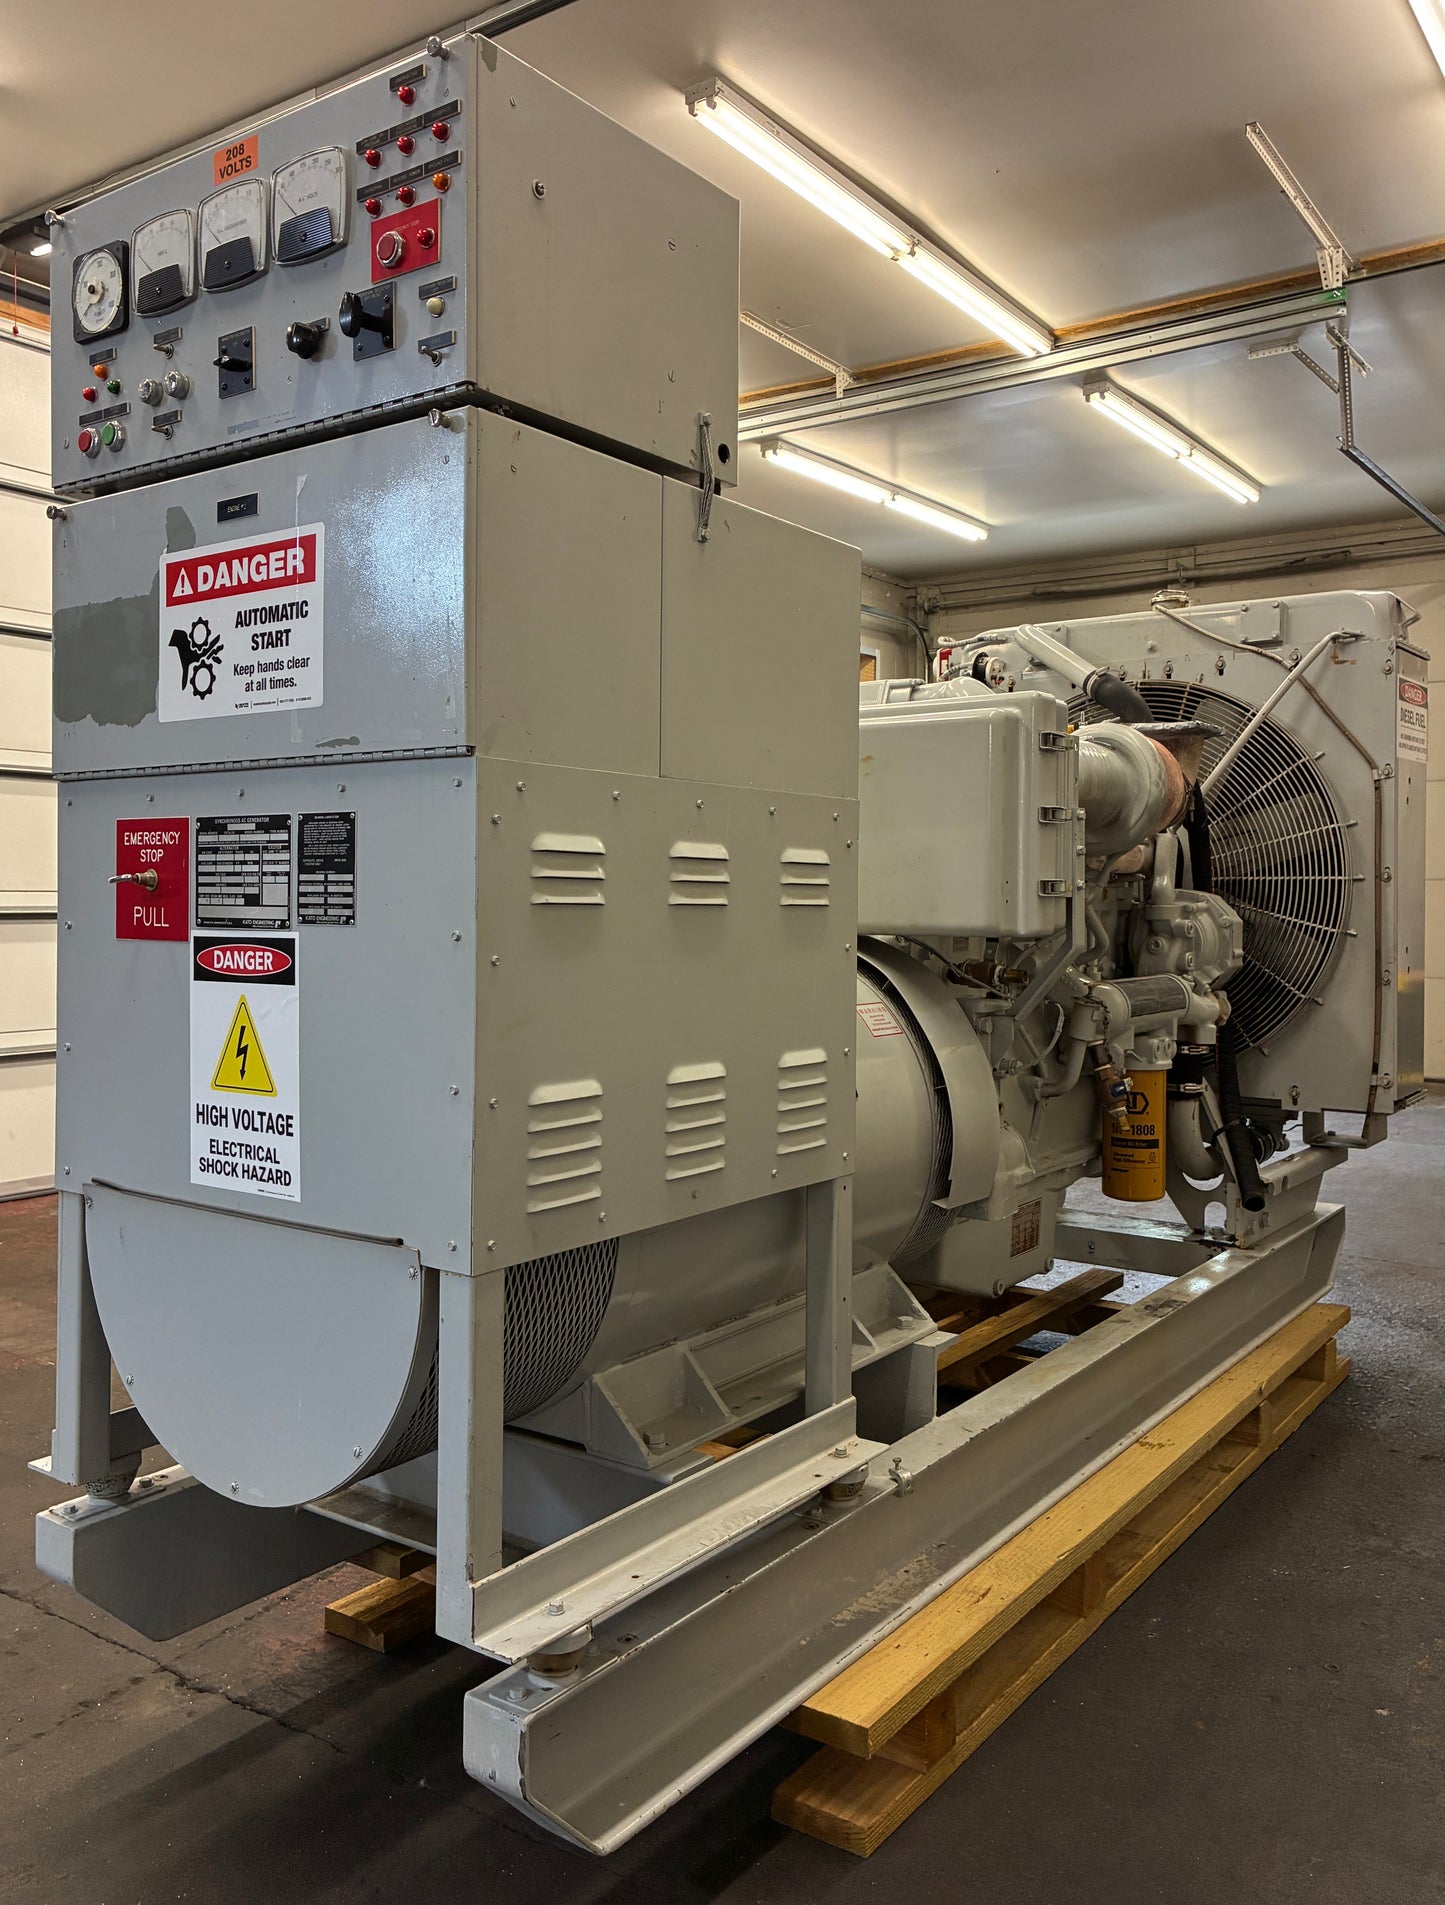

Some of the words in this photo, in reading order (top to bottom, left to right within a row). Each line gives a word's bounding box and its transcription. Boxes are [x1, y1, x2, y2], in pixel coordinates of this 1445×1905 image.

[225, 143, 245, 162] 208
[219, 155, 252, 179] VOLTS
[197, 547, 304, 593] DANGER
[234, 600, 308, 628] AUTOMATIC
[251, 628, 292, 651] START
[233, 662, 255, 678] Keep
[257, 658, 284, 674] hands
[286, 656, 310, 670] clear
[245, 680, 255, 692] at
[256, 677, 267, 691] all
[270, 674, 297, 689] times.
[1404, 685, 1422, 702] DANGER
[1400, 708, 1414, 726] DIESEL
[1416, 712, 1426, 728] FUEL
[124, 831, 181, 846] EMERGENCY
[140, 849, 164, 863] STOP
[133, 906, 170, 927] PULL
[213, 950, 273, 971] DANGER
[196, 1103, 228, 1128] HIGH
[232, 1107, 294, 1137] VOLTAGE
[209, 1138, 280, 1165] ELECTRICAL
[199, 1157, 239, 1178] SHOCK
[241, 1164, 292, 1187] HAZARD
